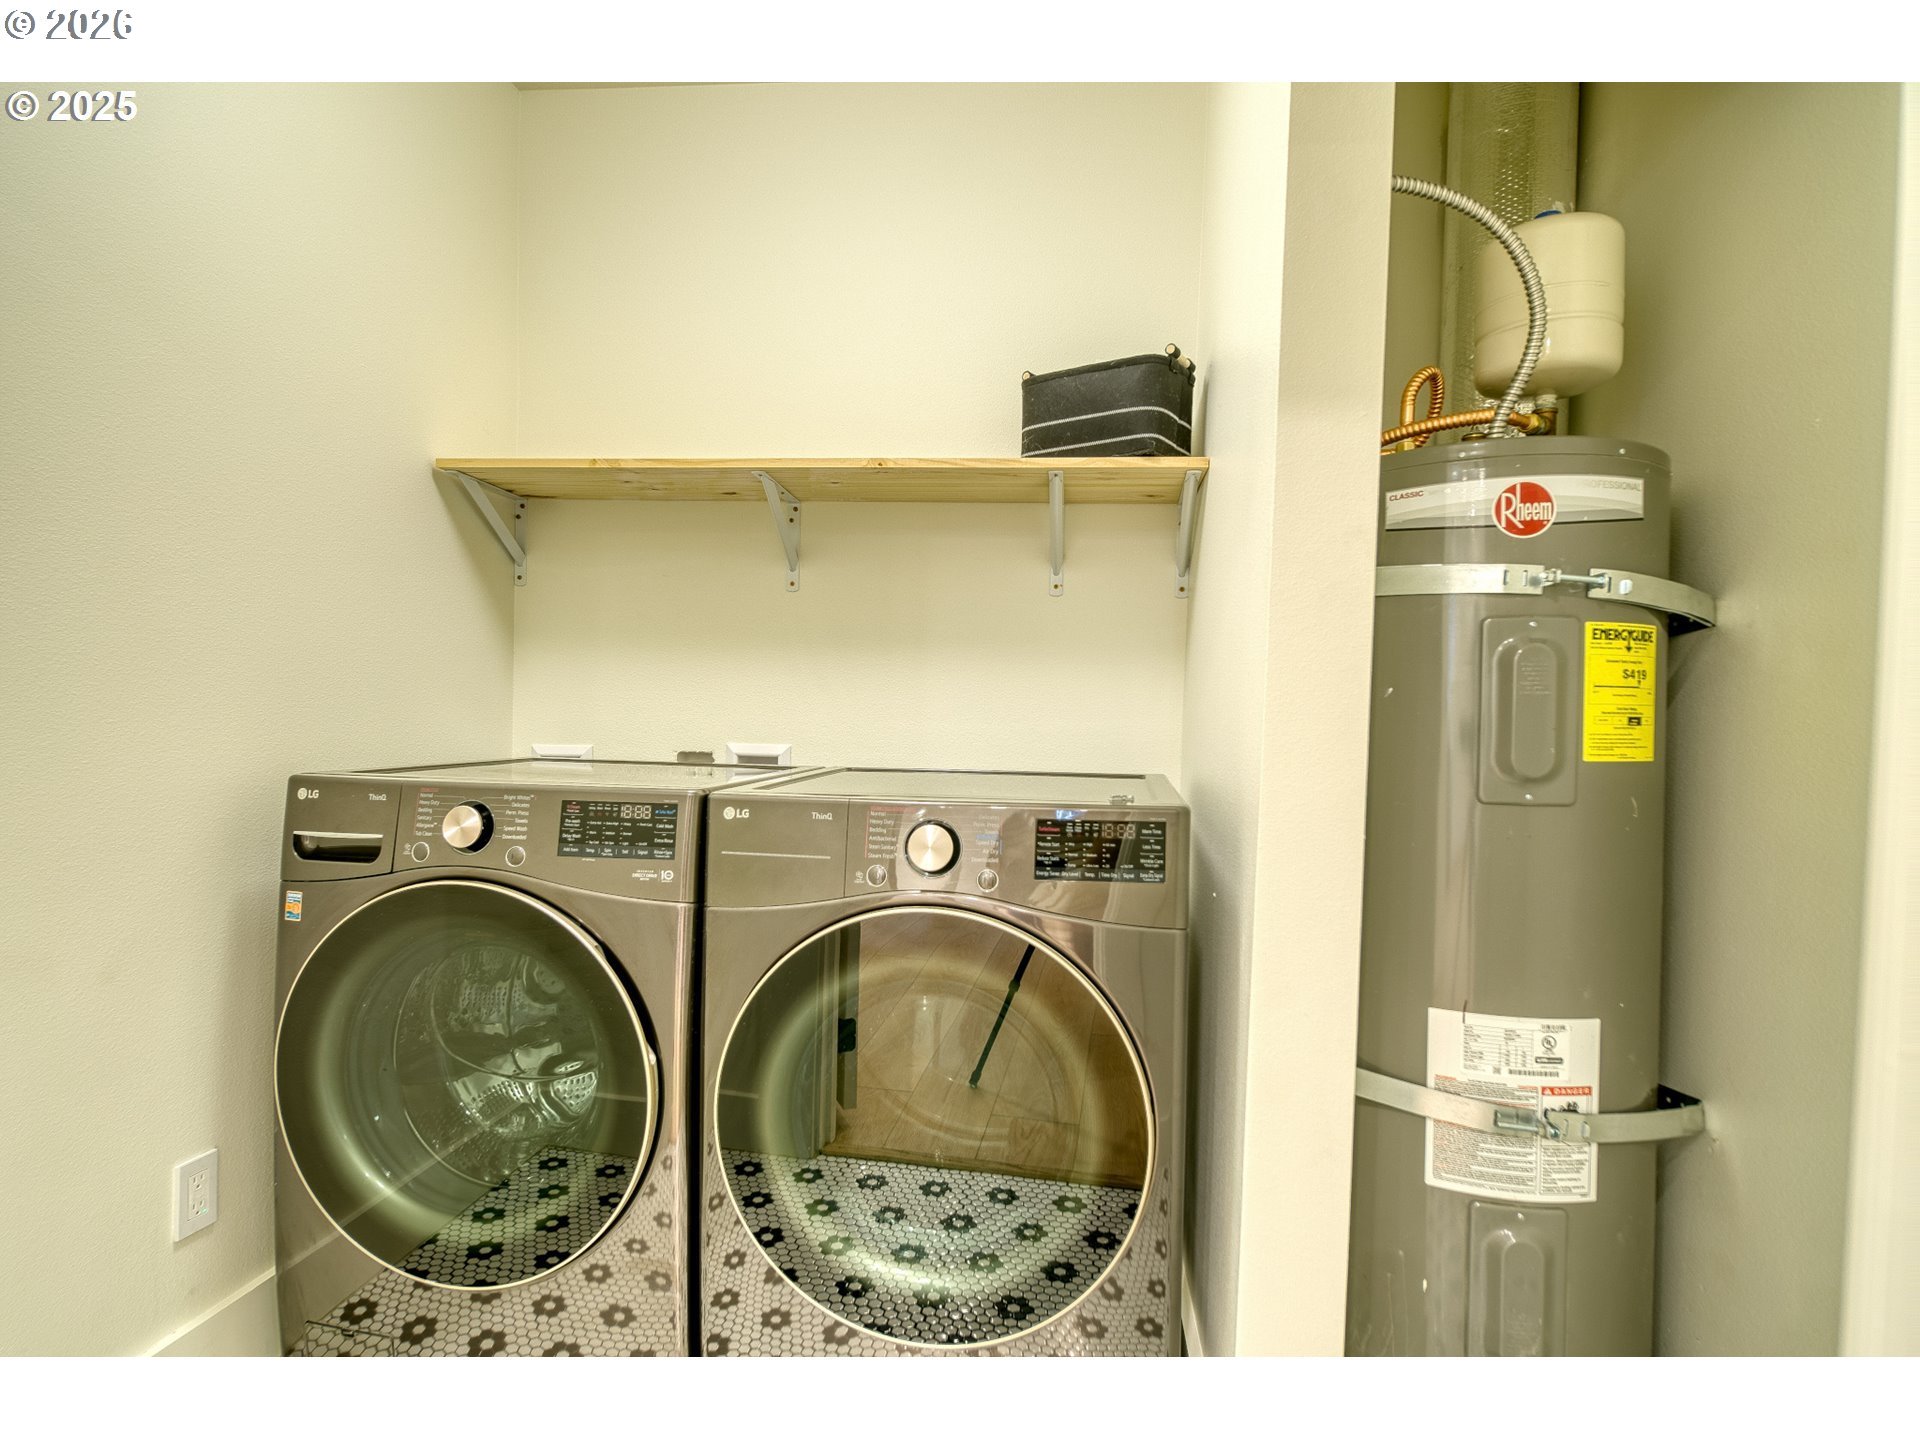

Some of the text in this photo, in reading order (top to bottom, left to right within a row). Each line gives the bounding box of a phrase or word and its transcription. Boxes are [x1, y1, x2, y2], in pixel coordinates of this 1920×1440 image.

[1389, 490, 1424, 501] CLASSIC
[1501, 482, 1552, 528] Rheem
[307, 789, 320, 799] LG
[368, 793, 387, 801] ThinQ
[736, 808, 750, 819] LG
[811, 811, 833, 820] ThinQ
[661, 870, 674, 881] 10
[1554, 1087, 1591, 1096] DANGER
